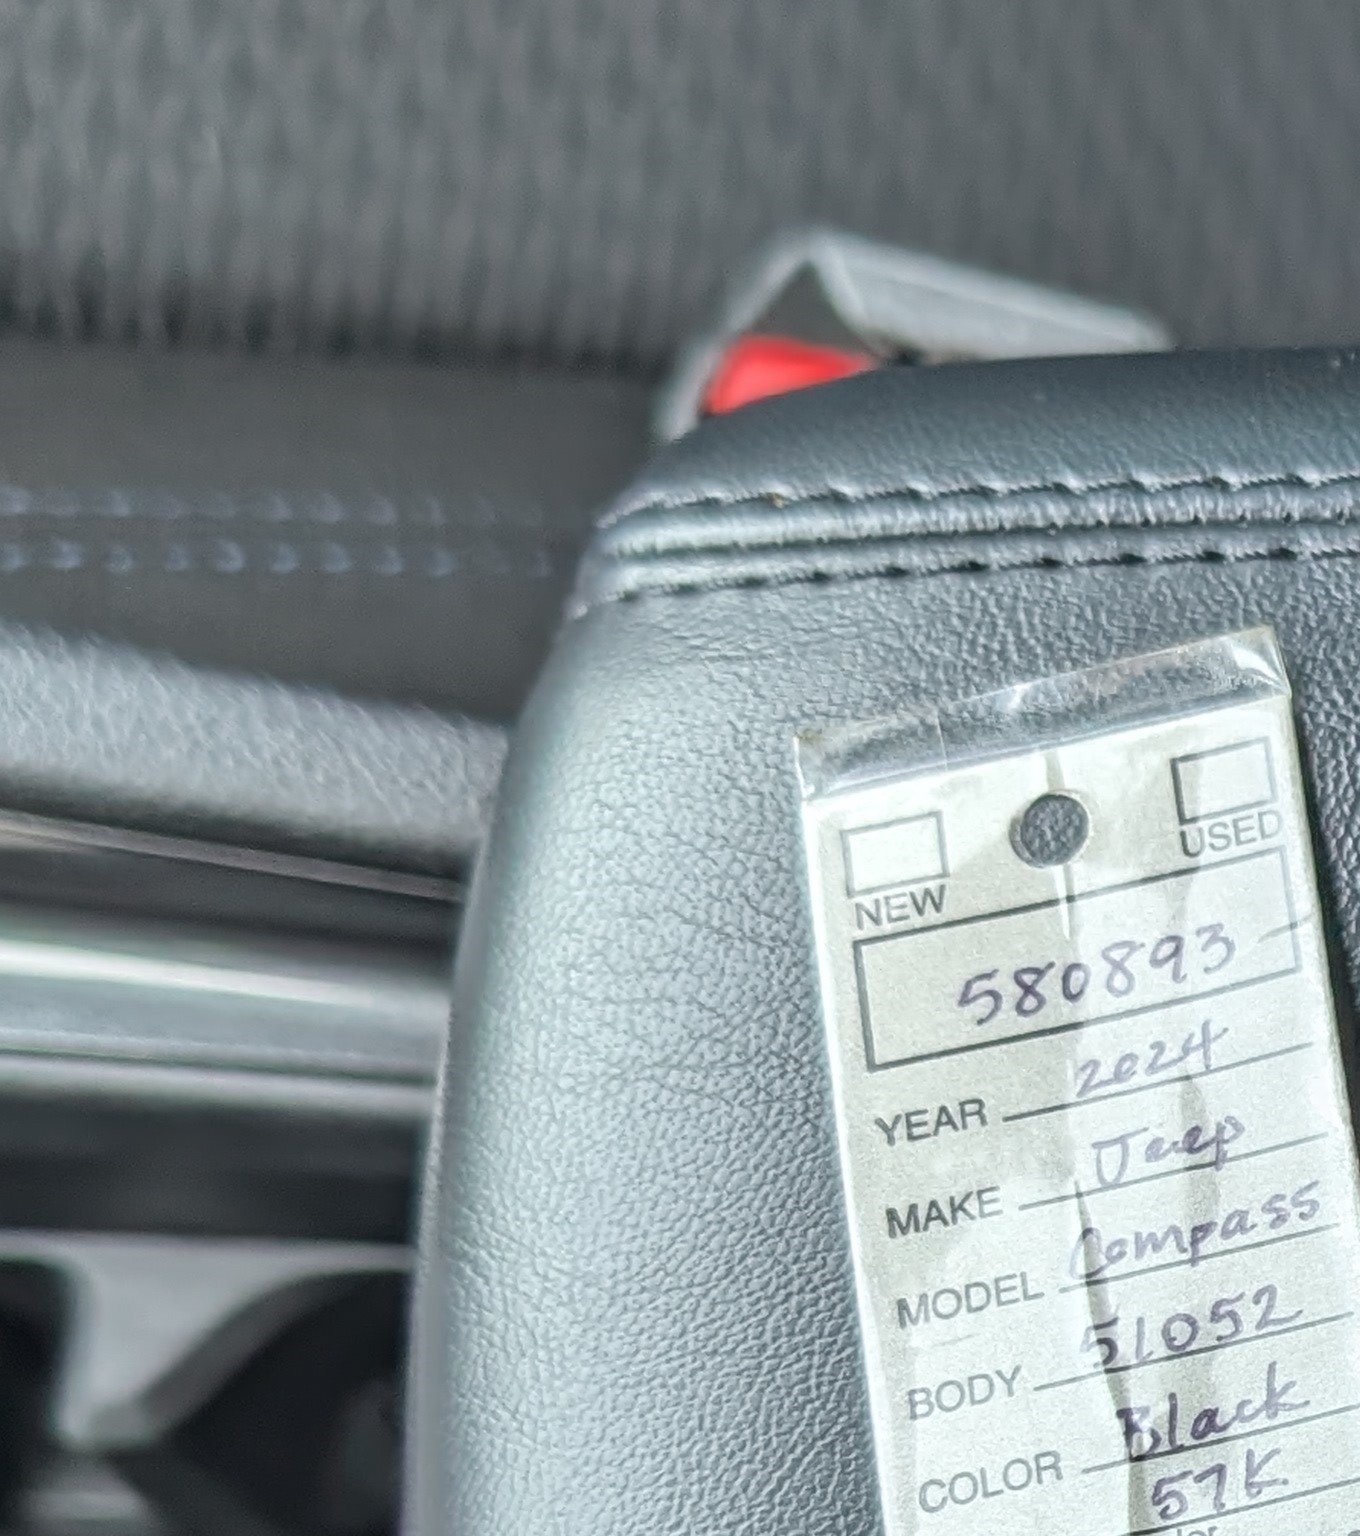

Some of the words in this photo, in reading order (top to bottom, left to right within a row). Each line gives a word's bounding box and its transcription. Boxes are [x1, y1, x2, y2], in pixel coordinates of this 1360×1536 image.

[1179, 810, 1284, 859] USED
[854, 884, 948, 930] NEW
[956, 922, 1237, 1026] 580893
[1076, 1019, 1229, 1098] 2024
[874, 1097, 988, 1147] YEAR
[1091, 1115, 1245, 1188] Jeep
[885, 1186, 1004, 1239] MAKE
[1068, 1180, 1320, 1280] Compass
[898, 1271, 1045, 1329] MODEL
[907, 1365, 1022, 1420] BODY
[1116, 1361, 1311, 1457] Black
[918, 1450, 1063, 1514] COLOR
[1152, 1447, 1290, 1521] 57K
